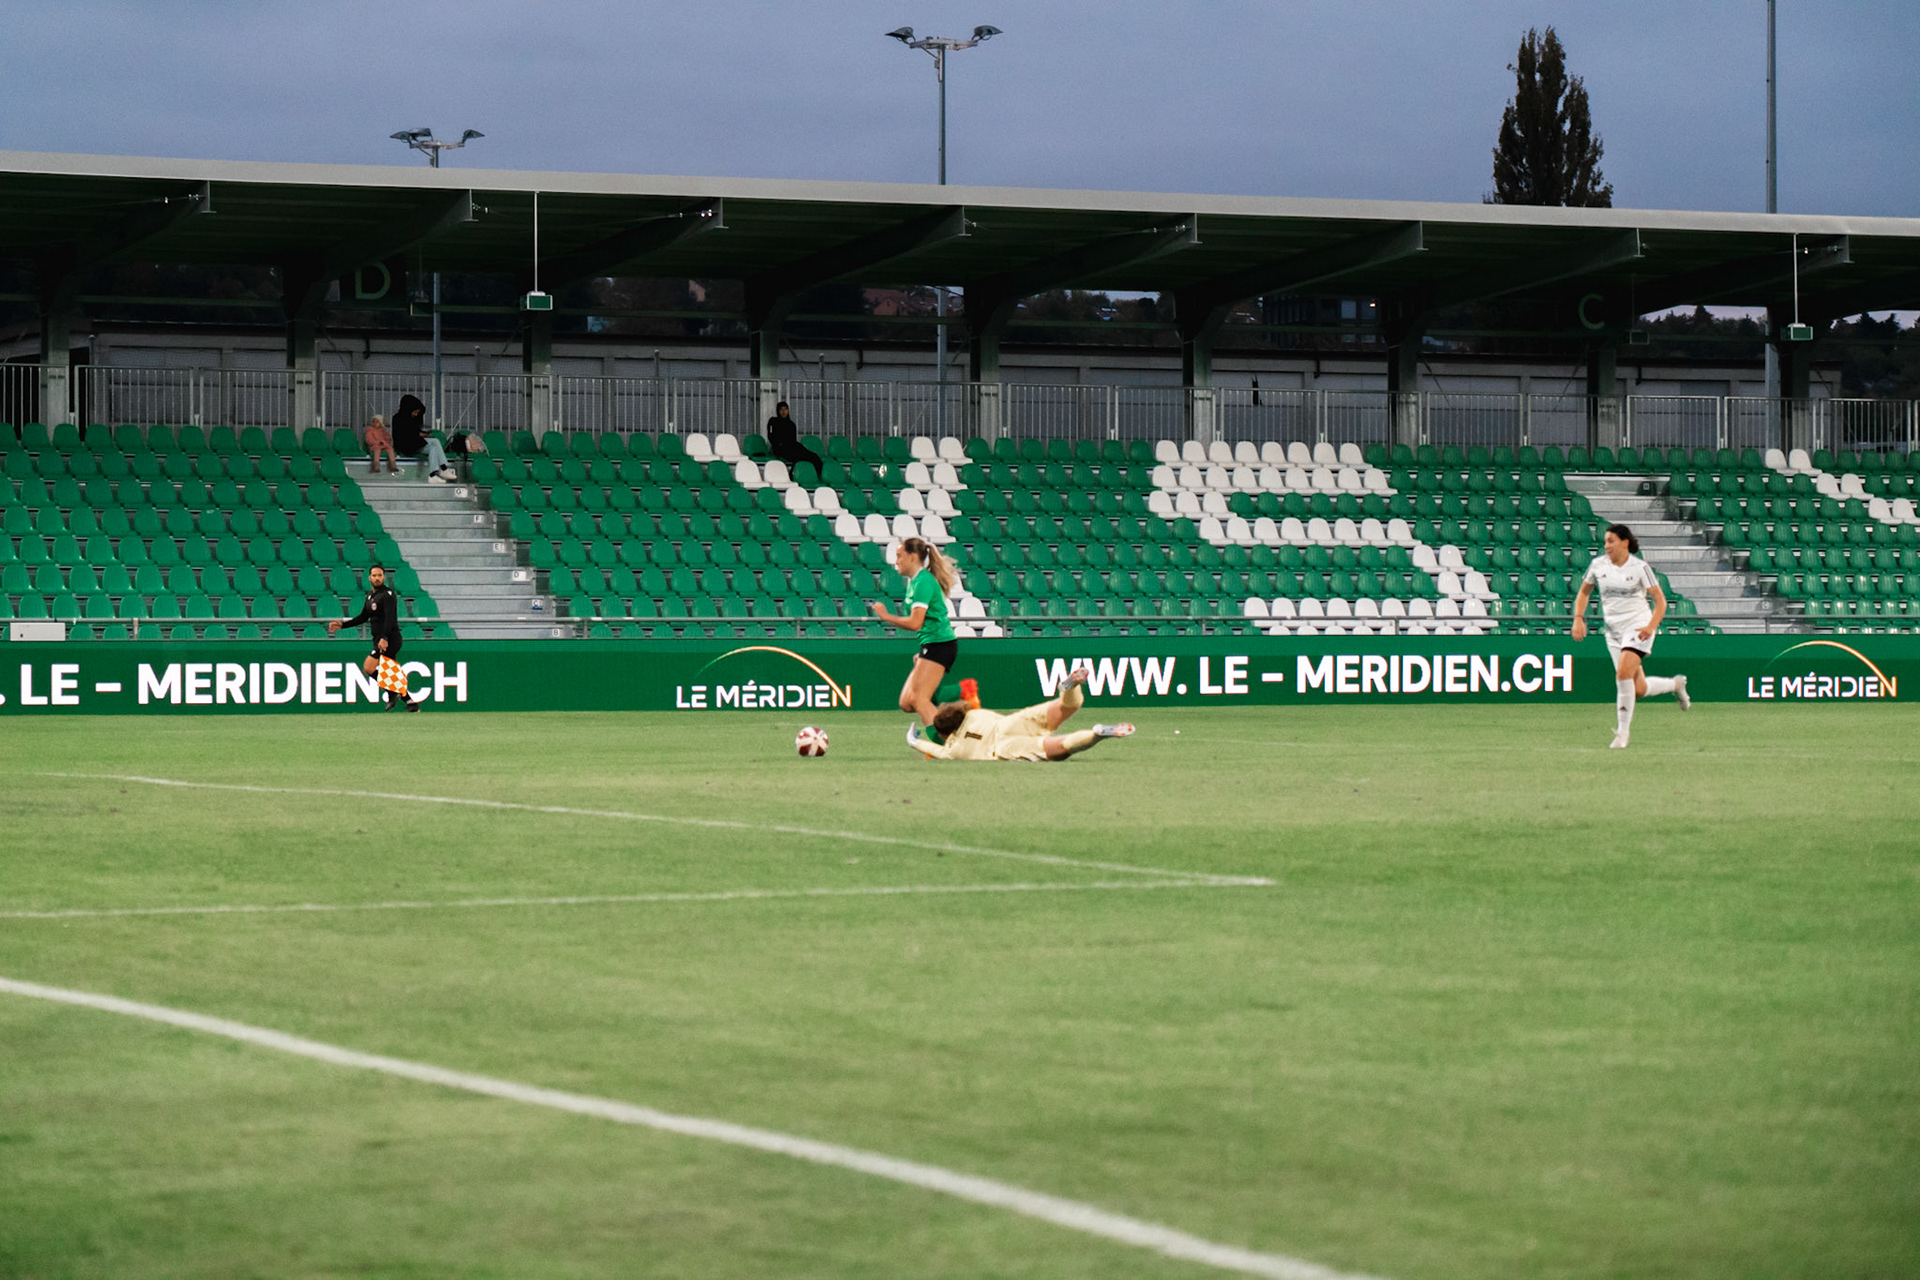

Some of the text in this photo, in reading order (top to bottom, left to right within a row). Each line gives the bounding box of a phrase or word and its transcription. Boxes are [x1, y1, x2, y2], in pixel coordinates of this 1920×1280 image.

[355, 263, 391, 300] D
[1578, 293, 1605, 330] C
[20, 664, 80, 705] LE
[1200, 656, 1248, 695] LE
[1297, 654, 1573, 693] MERIDIEN.CH
[1748, 671, 1897, 698] LE MÉRIDIEN
[676, 680, 851, 708] LE MÉRIDIEN
